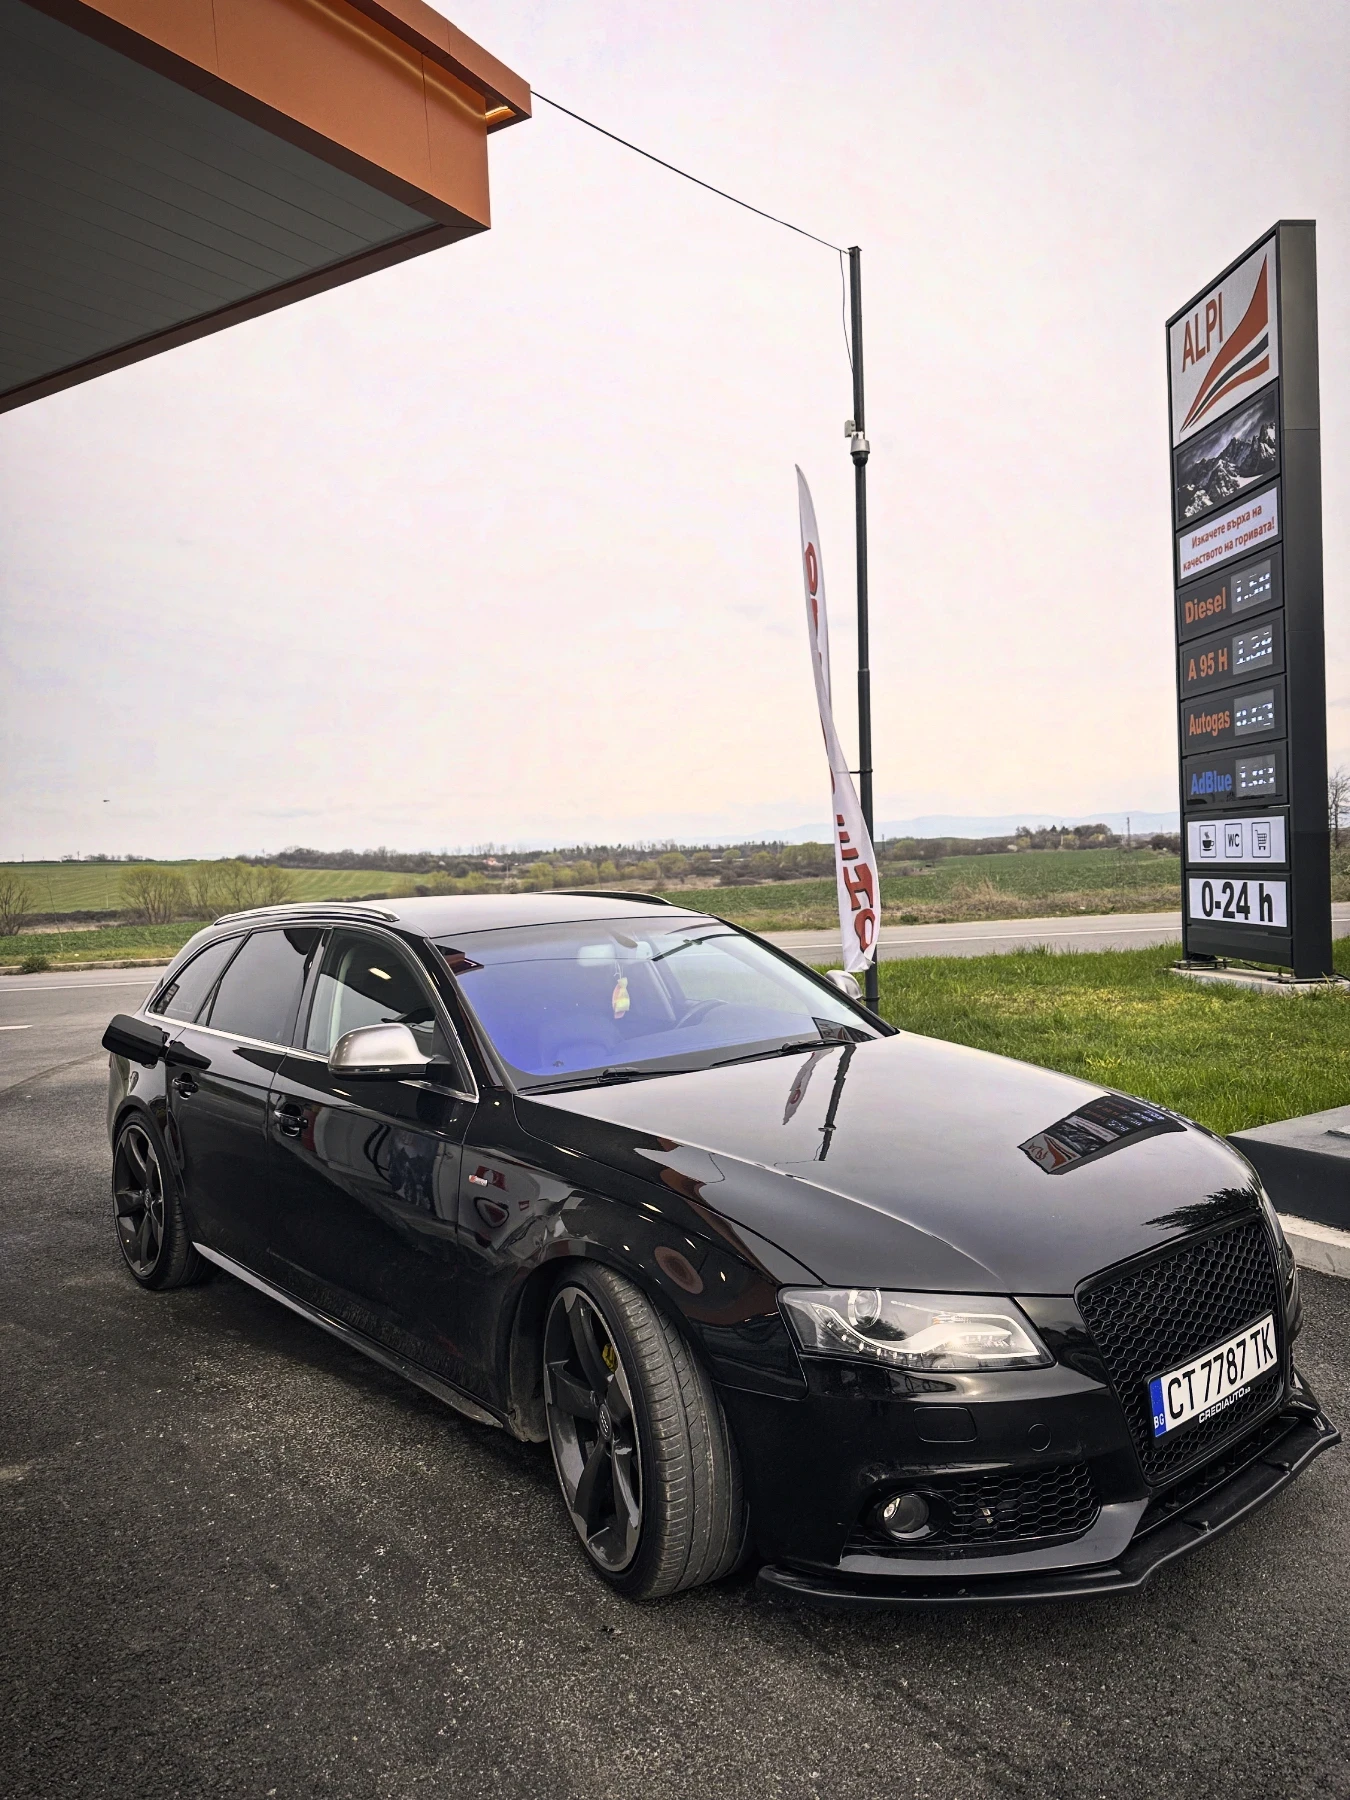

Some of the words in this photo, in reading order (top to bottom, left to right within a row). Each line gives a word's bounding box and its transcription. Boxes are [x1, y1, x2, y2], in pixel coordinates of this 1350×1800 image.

[1182, 291, 1224, 373] ALPI
[1191, 524, 1226, 549] Изкачете
[1226, 511, 1251, 530] върха
[1252, 505, 1262, 518] на
[1183, 546, 1223, 572] качеството
[1224, 541, 1234, 552] на
[1234, 516, 1275, 547] горивата!
[1184, 587, 1227, 624] Diesel
[1188, 658, 1197, 681] A
[1200, 651, 1215, 678] 95
[1189, 710, 1231, 737] Autogas
[1191, 770, 1232, 795] AdBlue
[1228, 833, 1240, 847] WC
[1201, 880, 1251, 921] 0-24
[1258, 882, 1274, 923] h
[1153, 1412, 1165, 1430] BG
